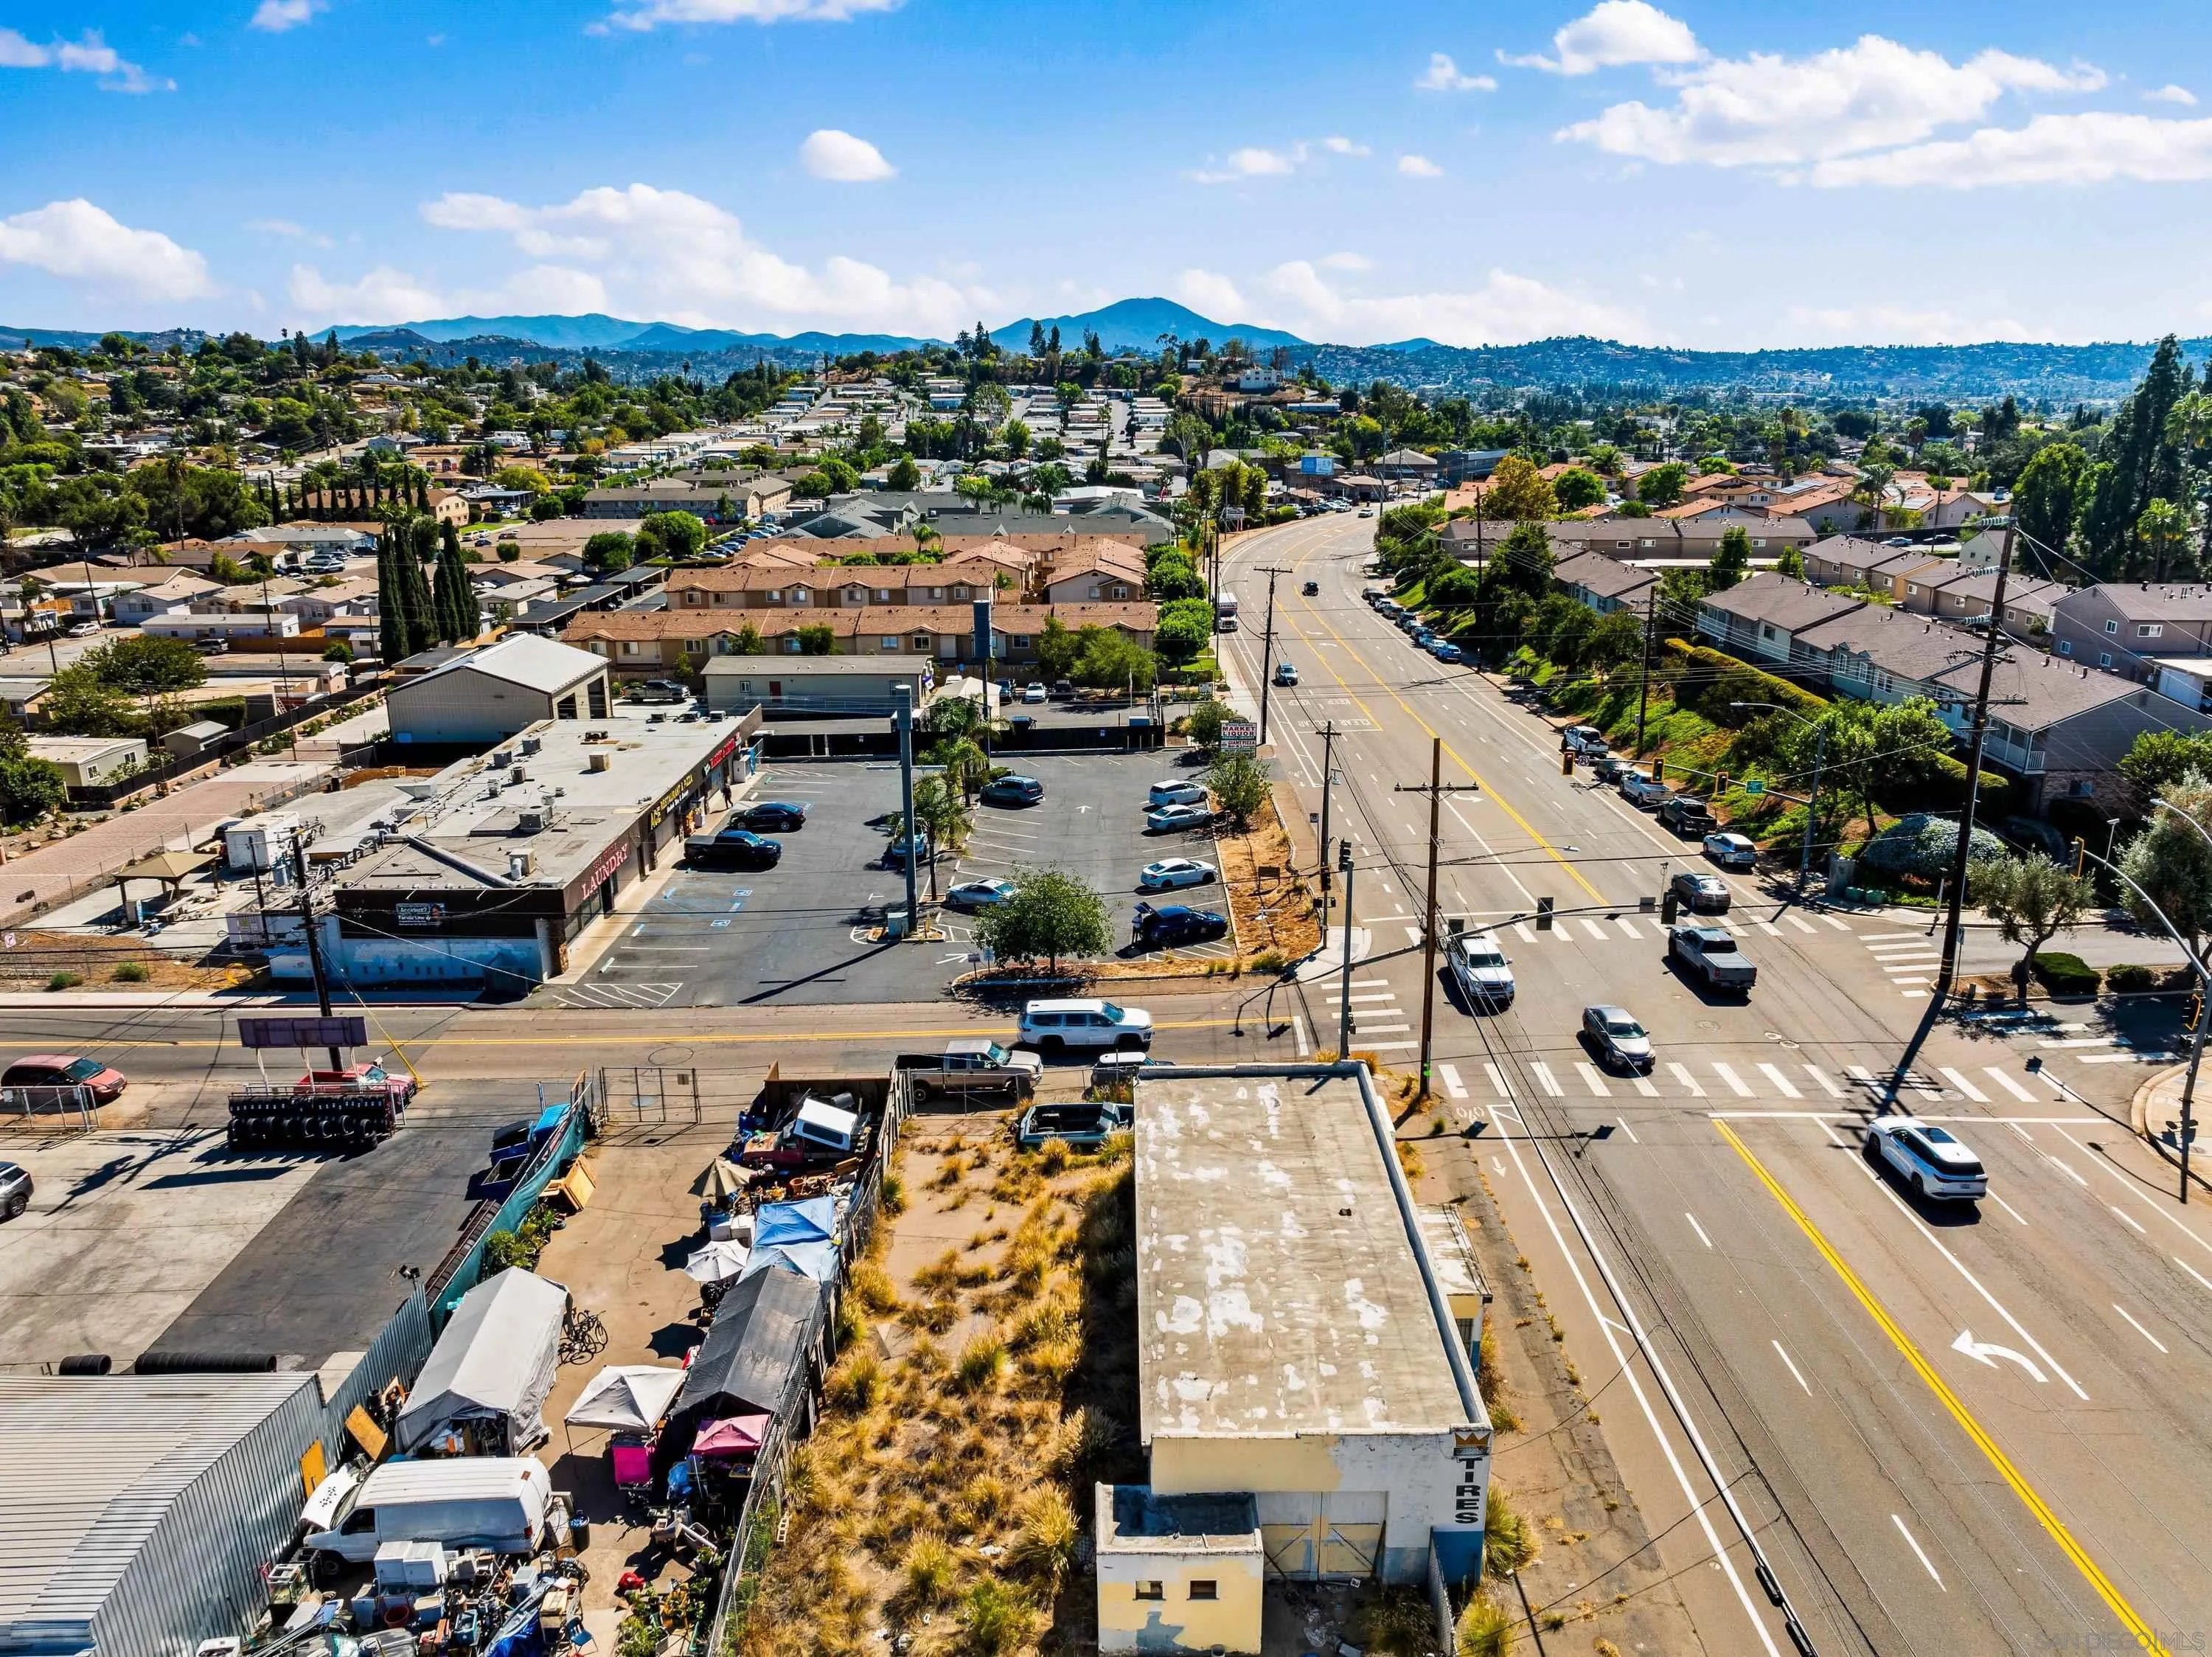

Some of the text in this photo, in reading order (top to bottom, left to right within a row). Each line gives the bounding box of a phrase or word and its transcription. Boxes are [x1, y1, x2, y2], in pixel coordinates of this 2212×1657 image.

[650, 806, 661, 830] ACE
[582, 843, 627, 900] LAUNDRY
[1455, 1457, 1483, 1524] TIRES
